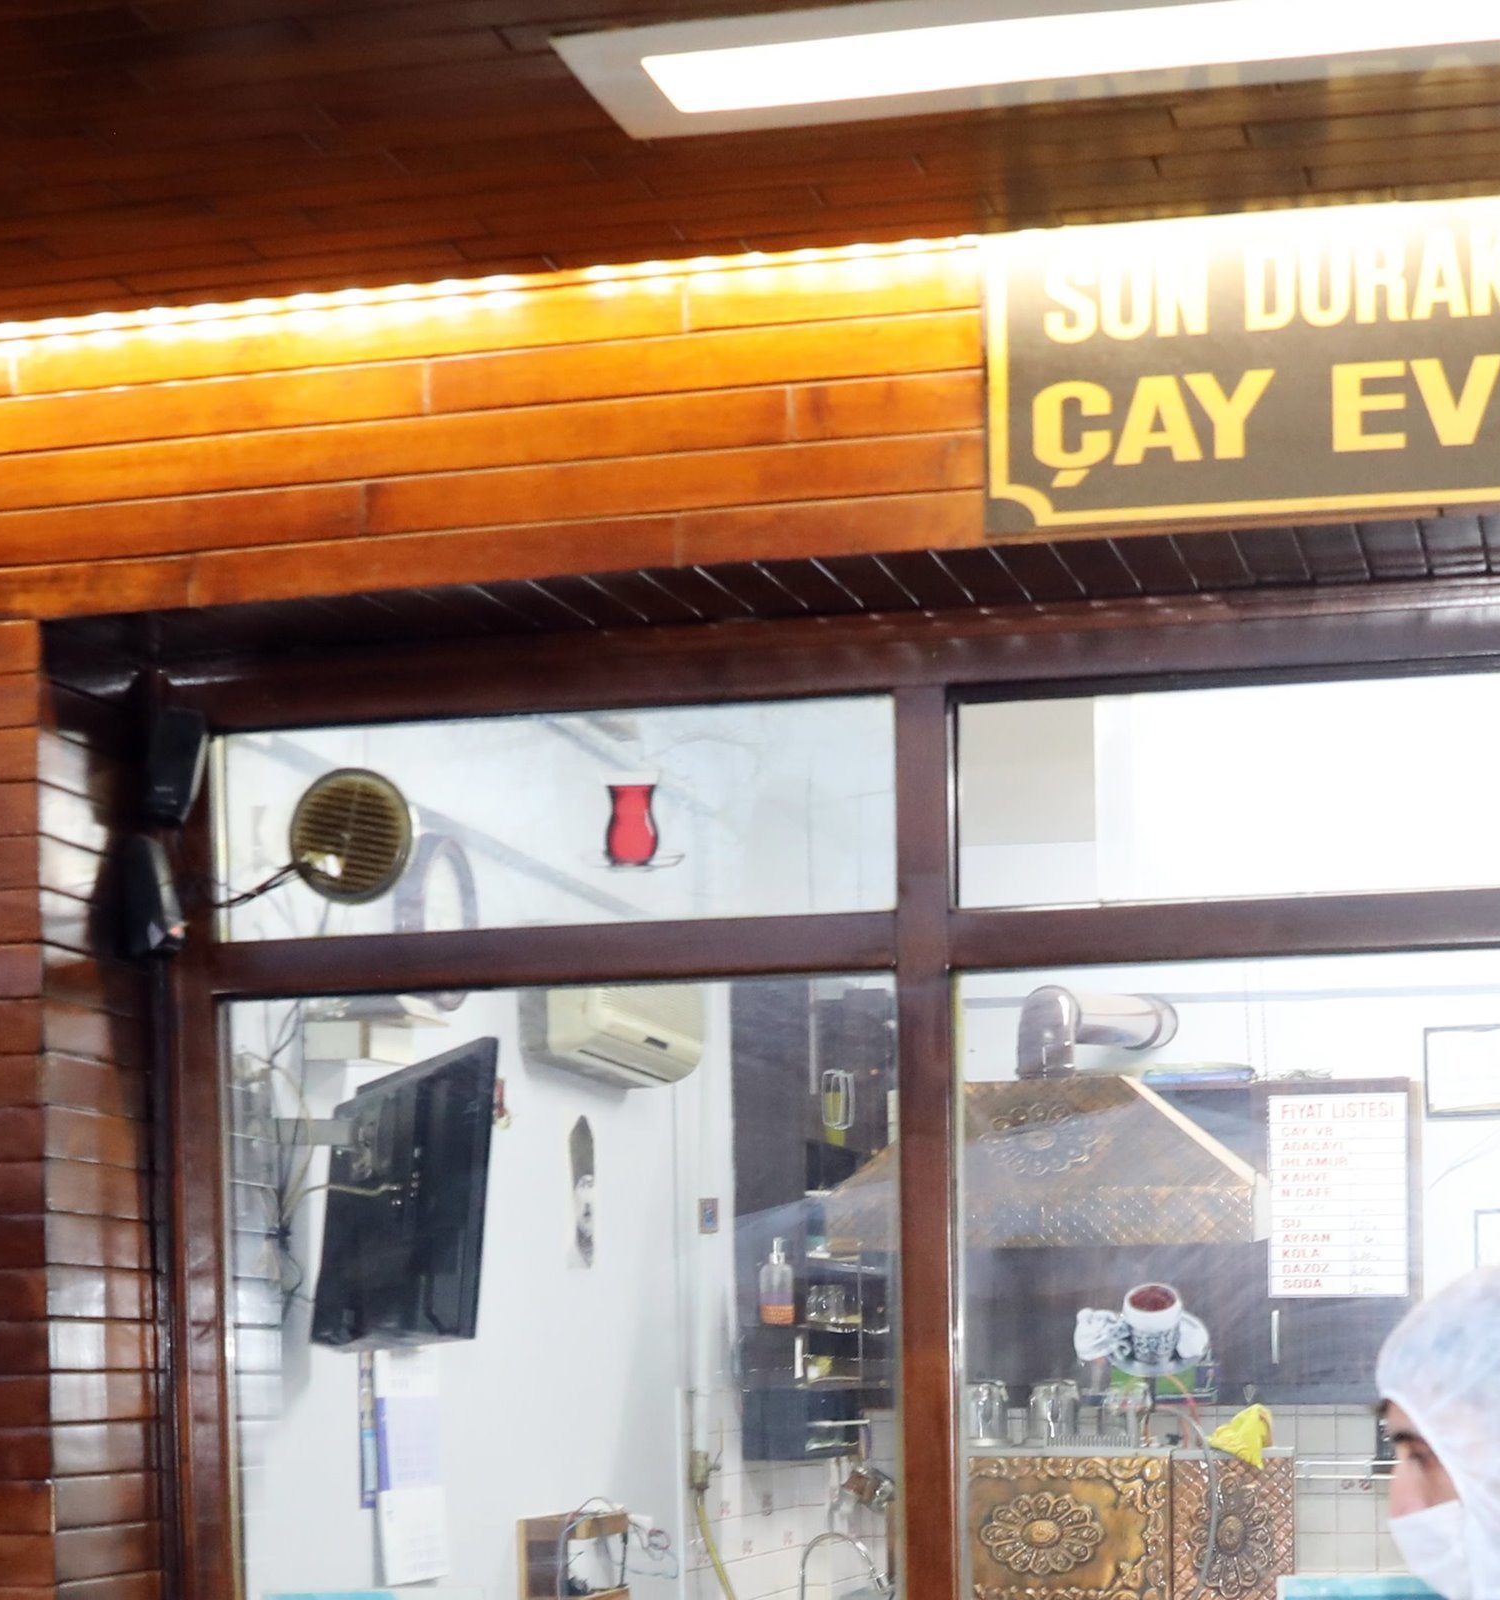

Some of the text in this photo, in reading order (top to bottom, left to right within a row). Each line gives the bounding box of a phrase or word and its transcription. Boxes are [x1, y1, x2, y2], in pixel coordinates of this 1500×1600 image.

[1031, 369, 1275, 488] ÇAY
[1283, 1232, 1332, 1244] AYRAN
[1283, 1248, 1321, 1259] KOLA
[1283, 1278, 1323, 1290] SODA
